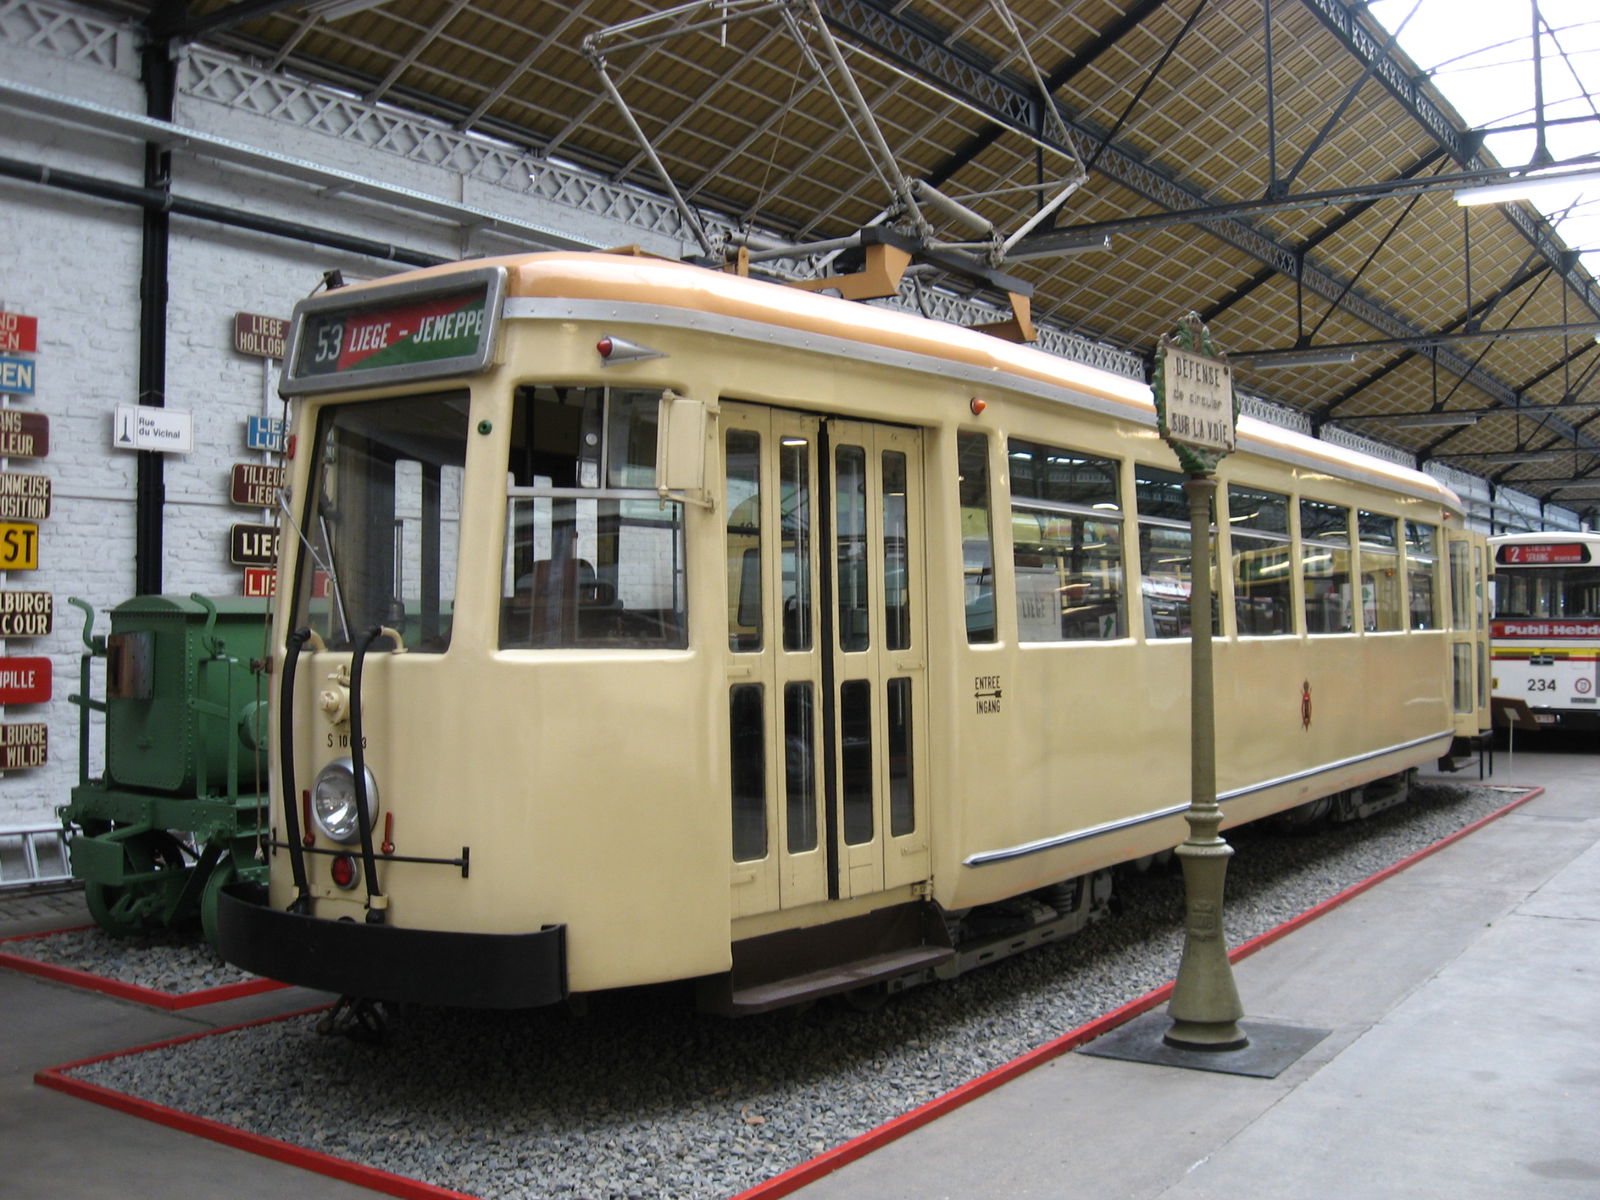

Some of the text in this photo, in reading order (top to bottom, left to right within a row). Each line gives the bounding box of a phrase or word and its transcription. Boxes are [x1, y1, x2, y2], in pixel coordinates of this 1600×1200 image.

[252, 315, 283, 338] LIEGE
[315, 324, 344, 362] 53
[350, 322, 392, 352] LIEGE
[413, 308, 485, 345] JEMEPPE
[0, 362, 32, 390] EN
[138, 417, 155, 427] Rue
[1172, 412, 1190, 435] SUR
[1193, 417, 1205, 439] LA
[138, 427, 181, 439] du Vicinal
[1, 494, 47, 519] OSITION
[4, 529, 35, 563] ST
[1511, 546, 1520, 562] 2
[2, 614, 48, 634] COUR
[1504, 624, 1600, 636] Publi-Hebd
[974, 675, 1001, 690] ENTREE
[1527, 678, 1556, 691] 234
[976, 699, 1001, 714] INGANG
[7, 744, 46, 767] WILDE
